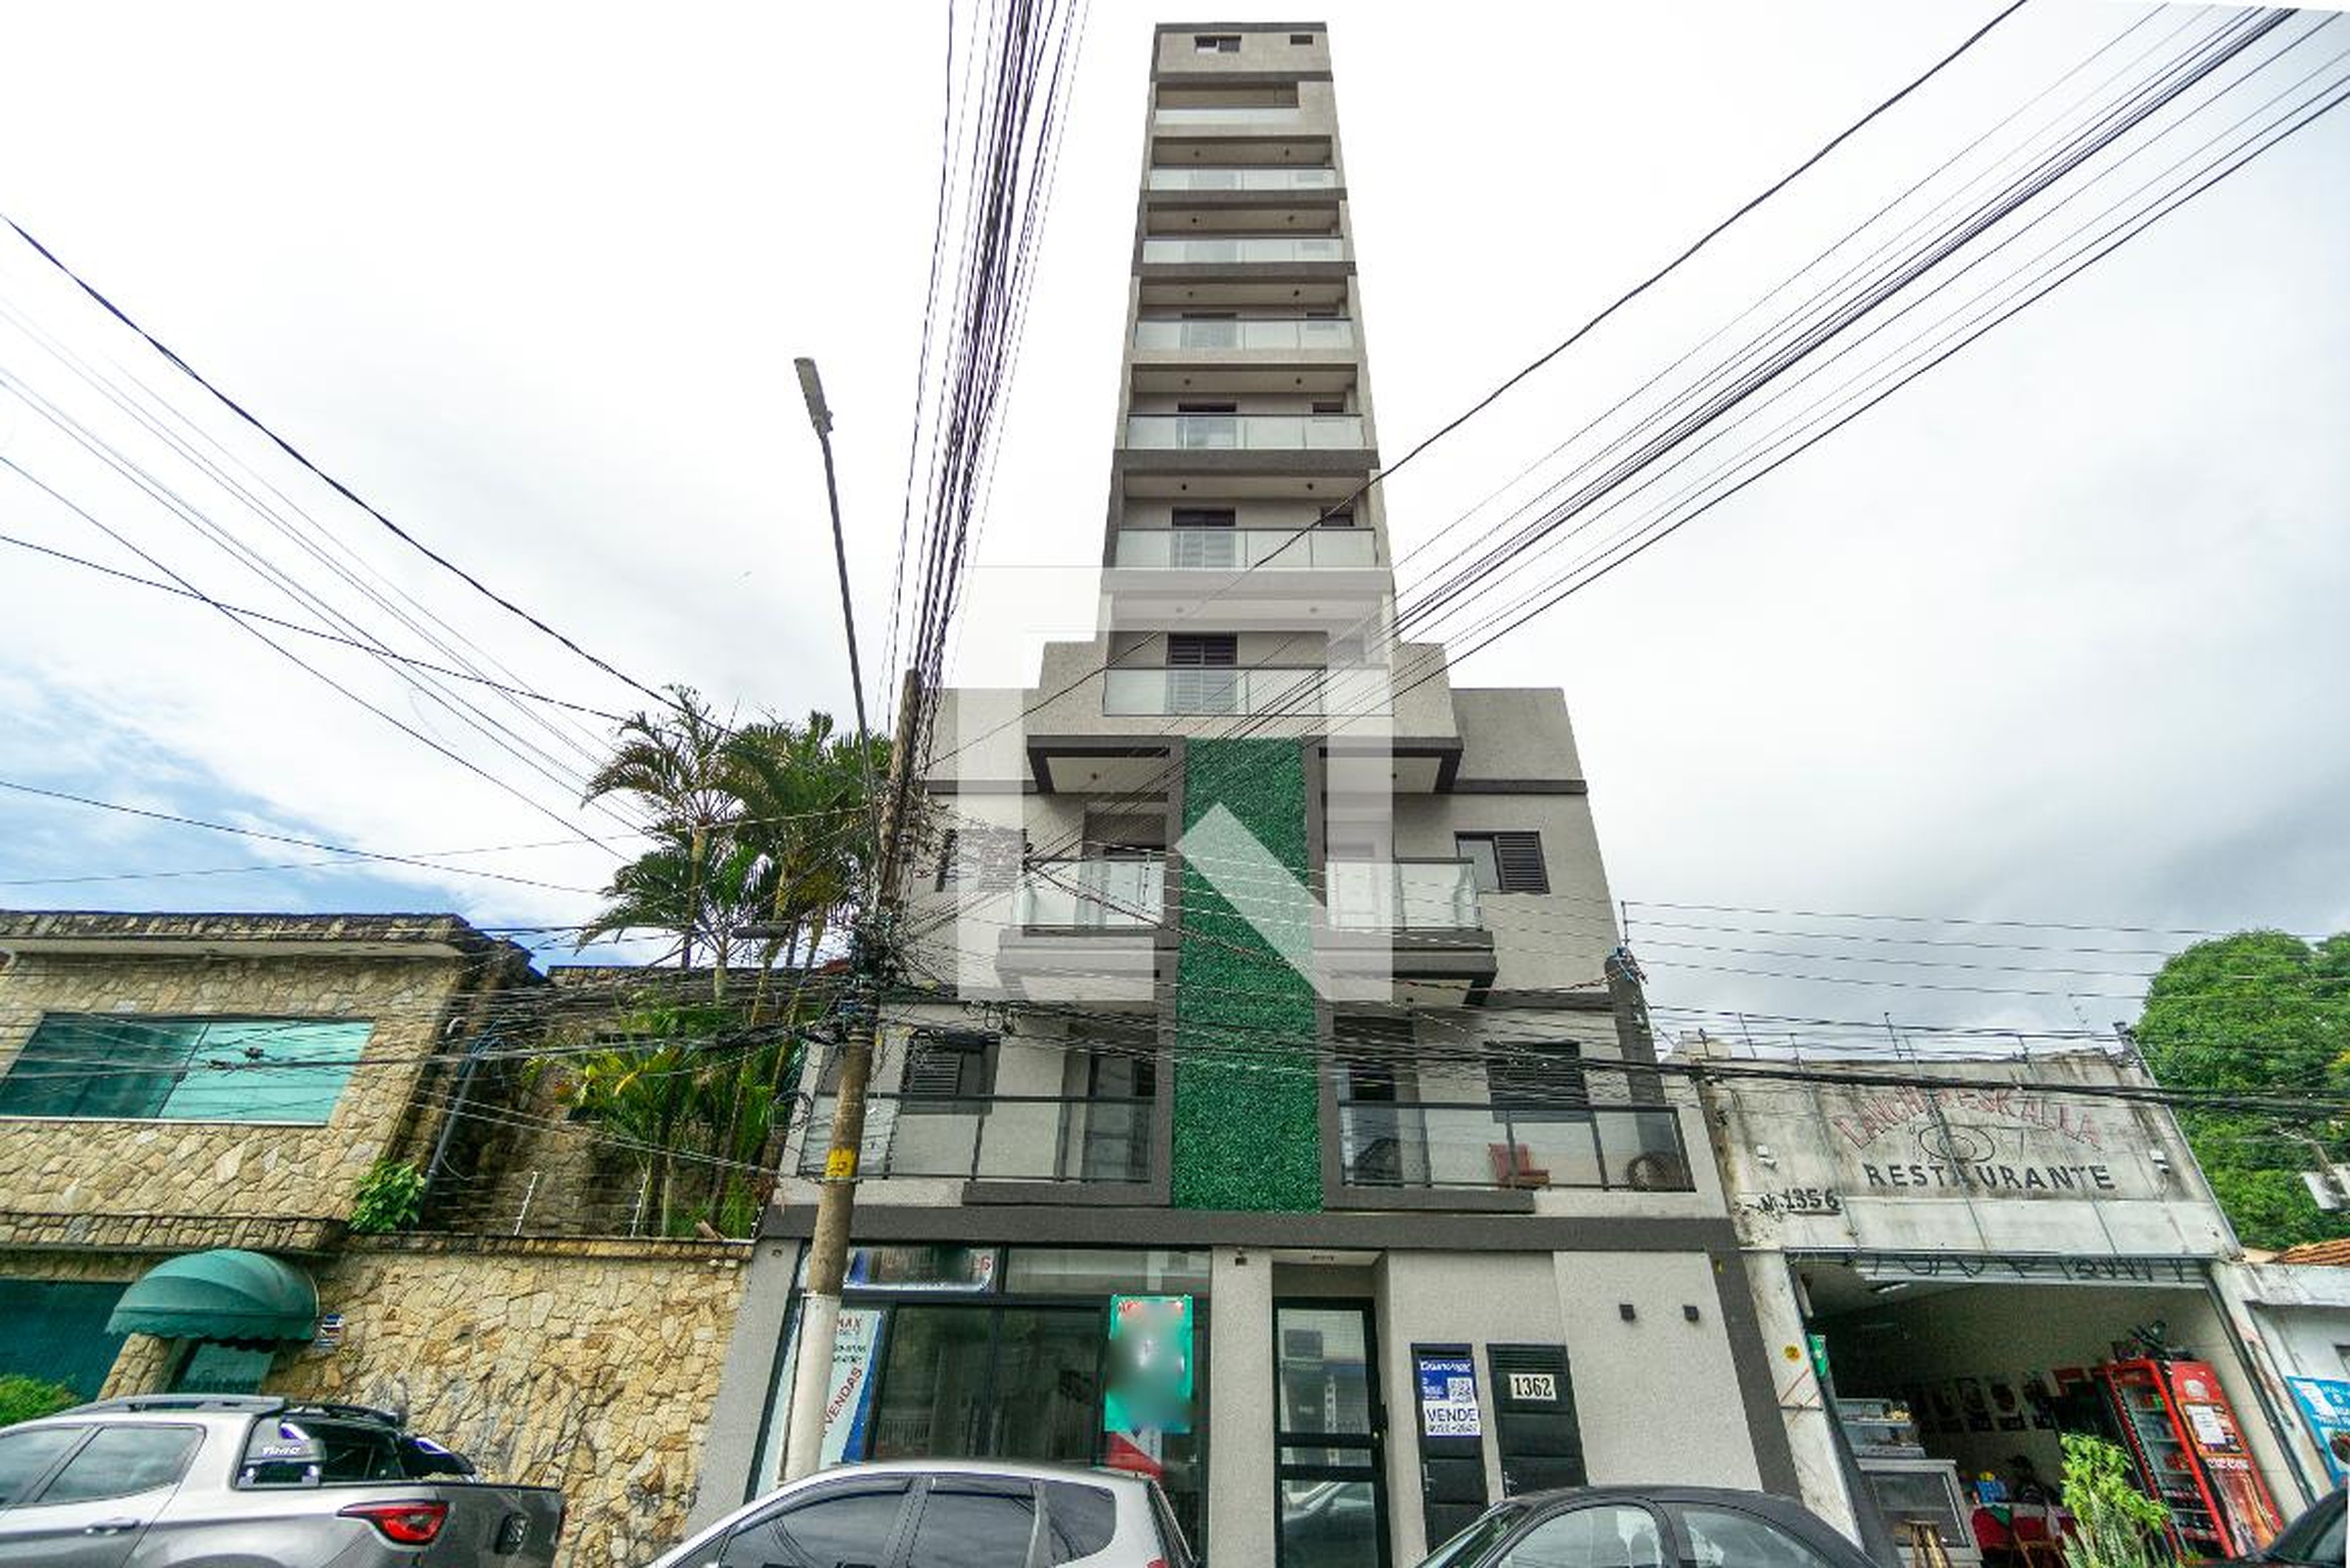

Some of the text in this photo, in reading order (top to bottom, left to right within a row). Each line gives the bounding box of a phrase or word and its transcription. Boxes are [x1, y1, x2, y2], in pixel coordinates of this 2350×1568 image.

[1862, 1163, 2116, 1190] RESTAURANTE
[825, 1367, 862, 1424] VENDAS
[1515, 1377, 1553, 1397] 1362
[1426, 1408, 1477, 1422] VENDE
